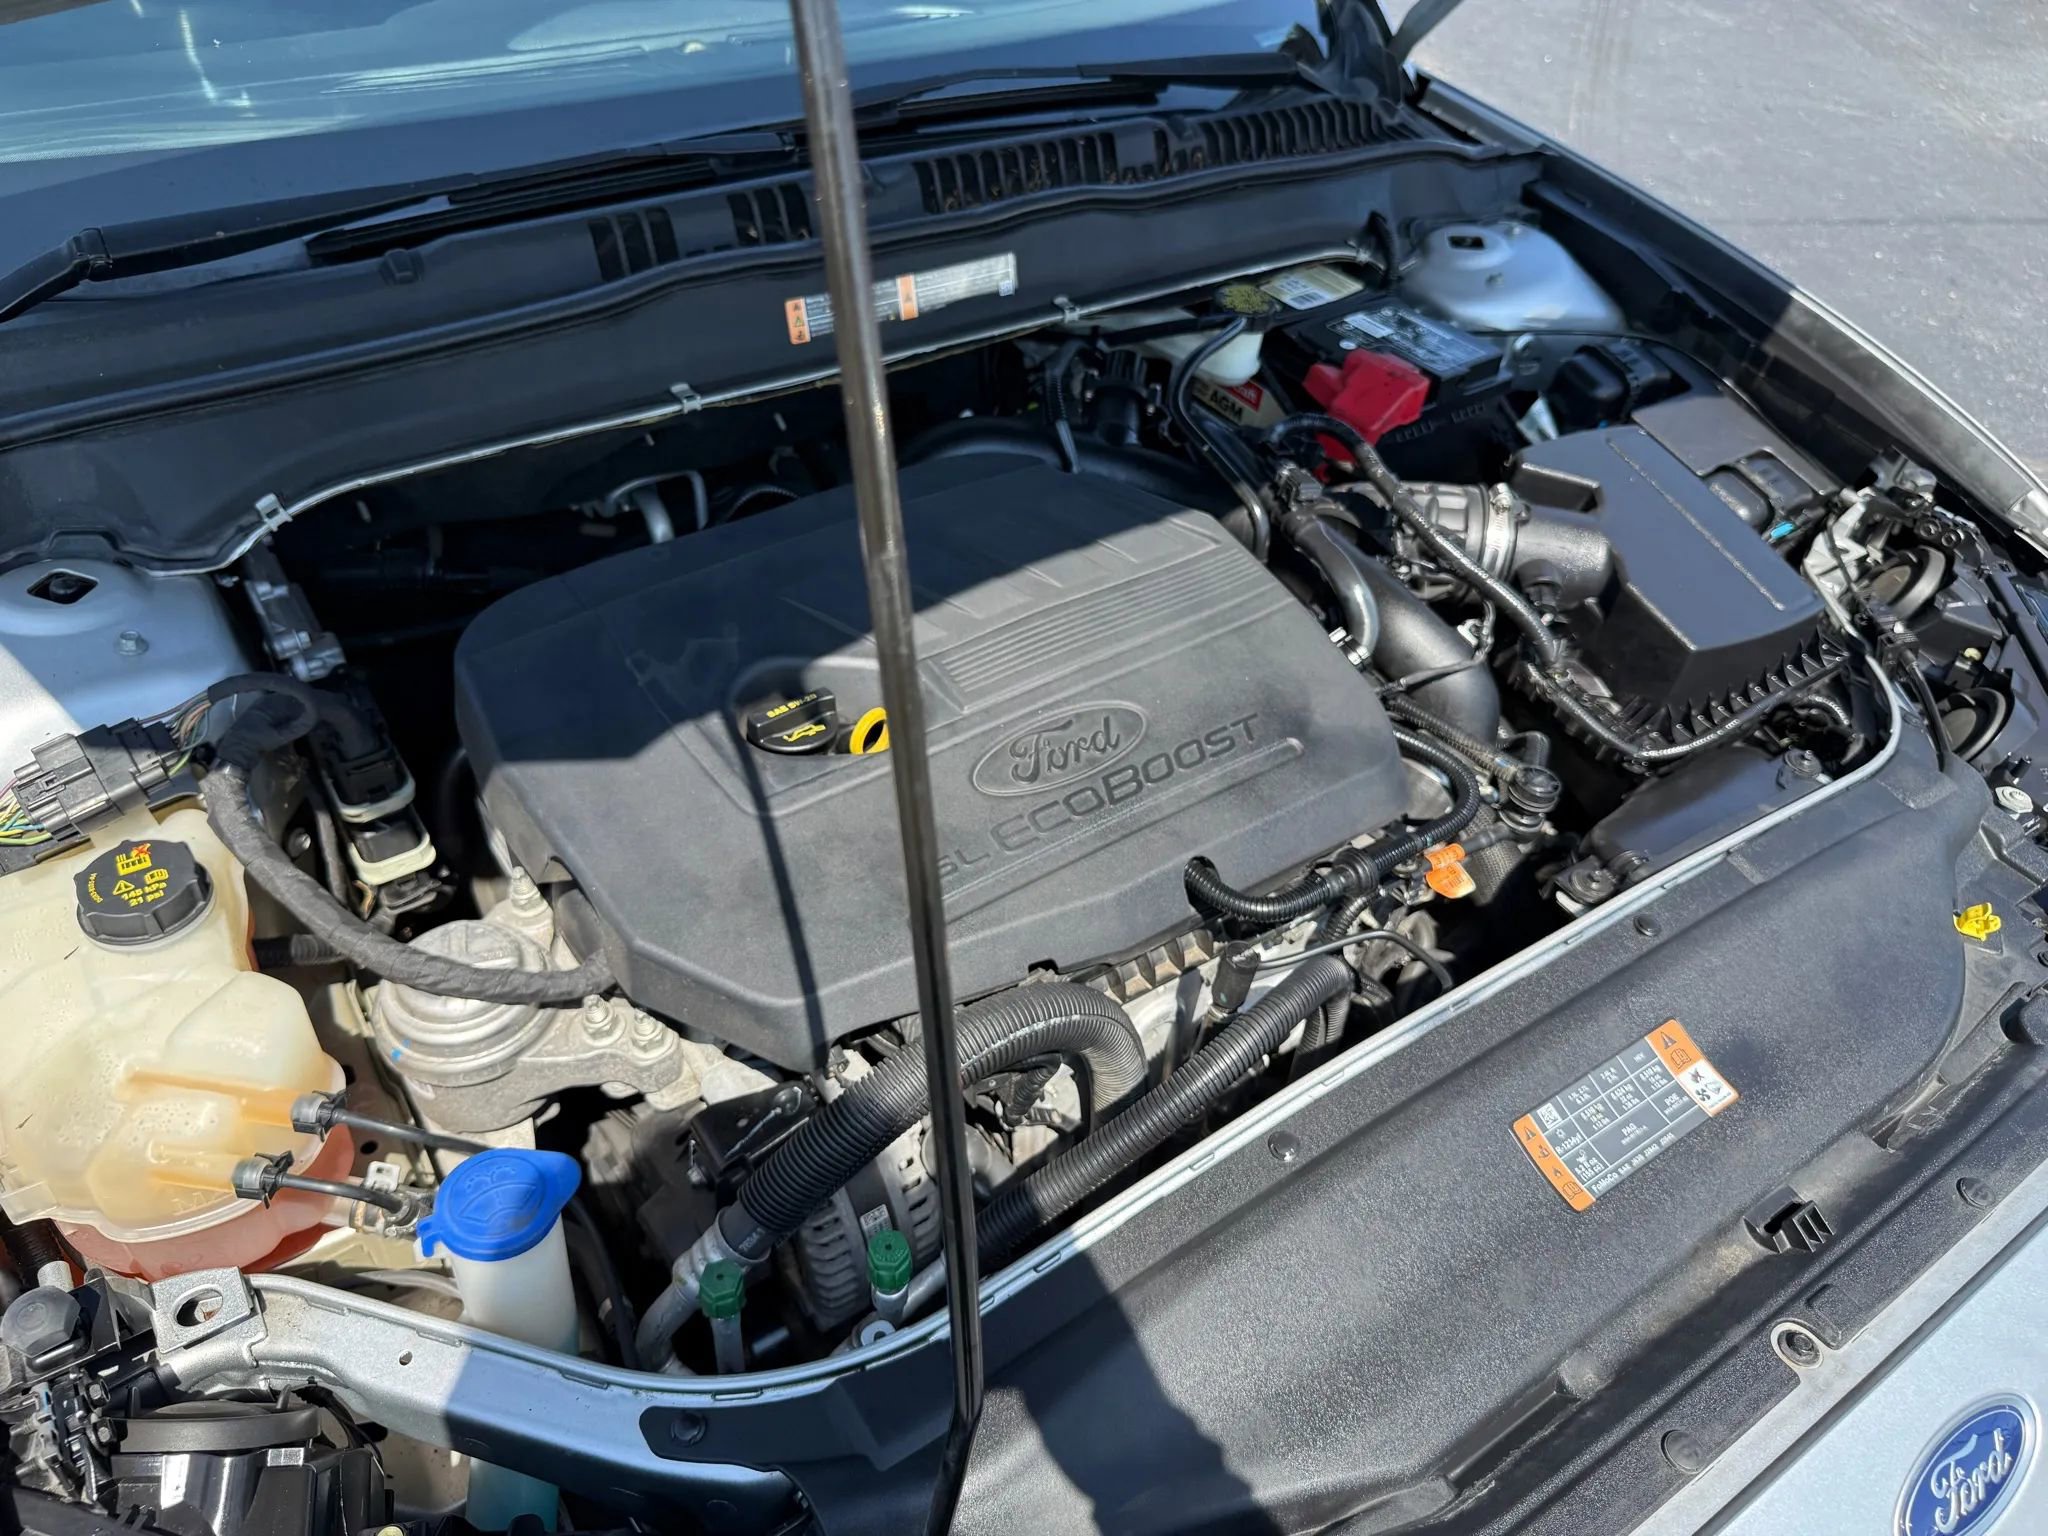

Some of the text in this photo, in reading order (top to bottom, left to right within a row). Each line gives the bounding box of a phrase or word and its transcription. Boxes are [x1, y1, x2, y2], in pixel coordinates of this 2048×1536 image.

[1210, 389, 1243, 422] AGM
[766, 704, 789, 718] SAE
[1009, 717, 1122, 785] Ford
[129, 890, 164, 907] 21 psi
[1592, 1173, 1618, 1192] FoMoCo
[1930, 1427, 2013, 1534] Ford
